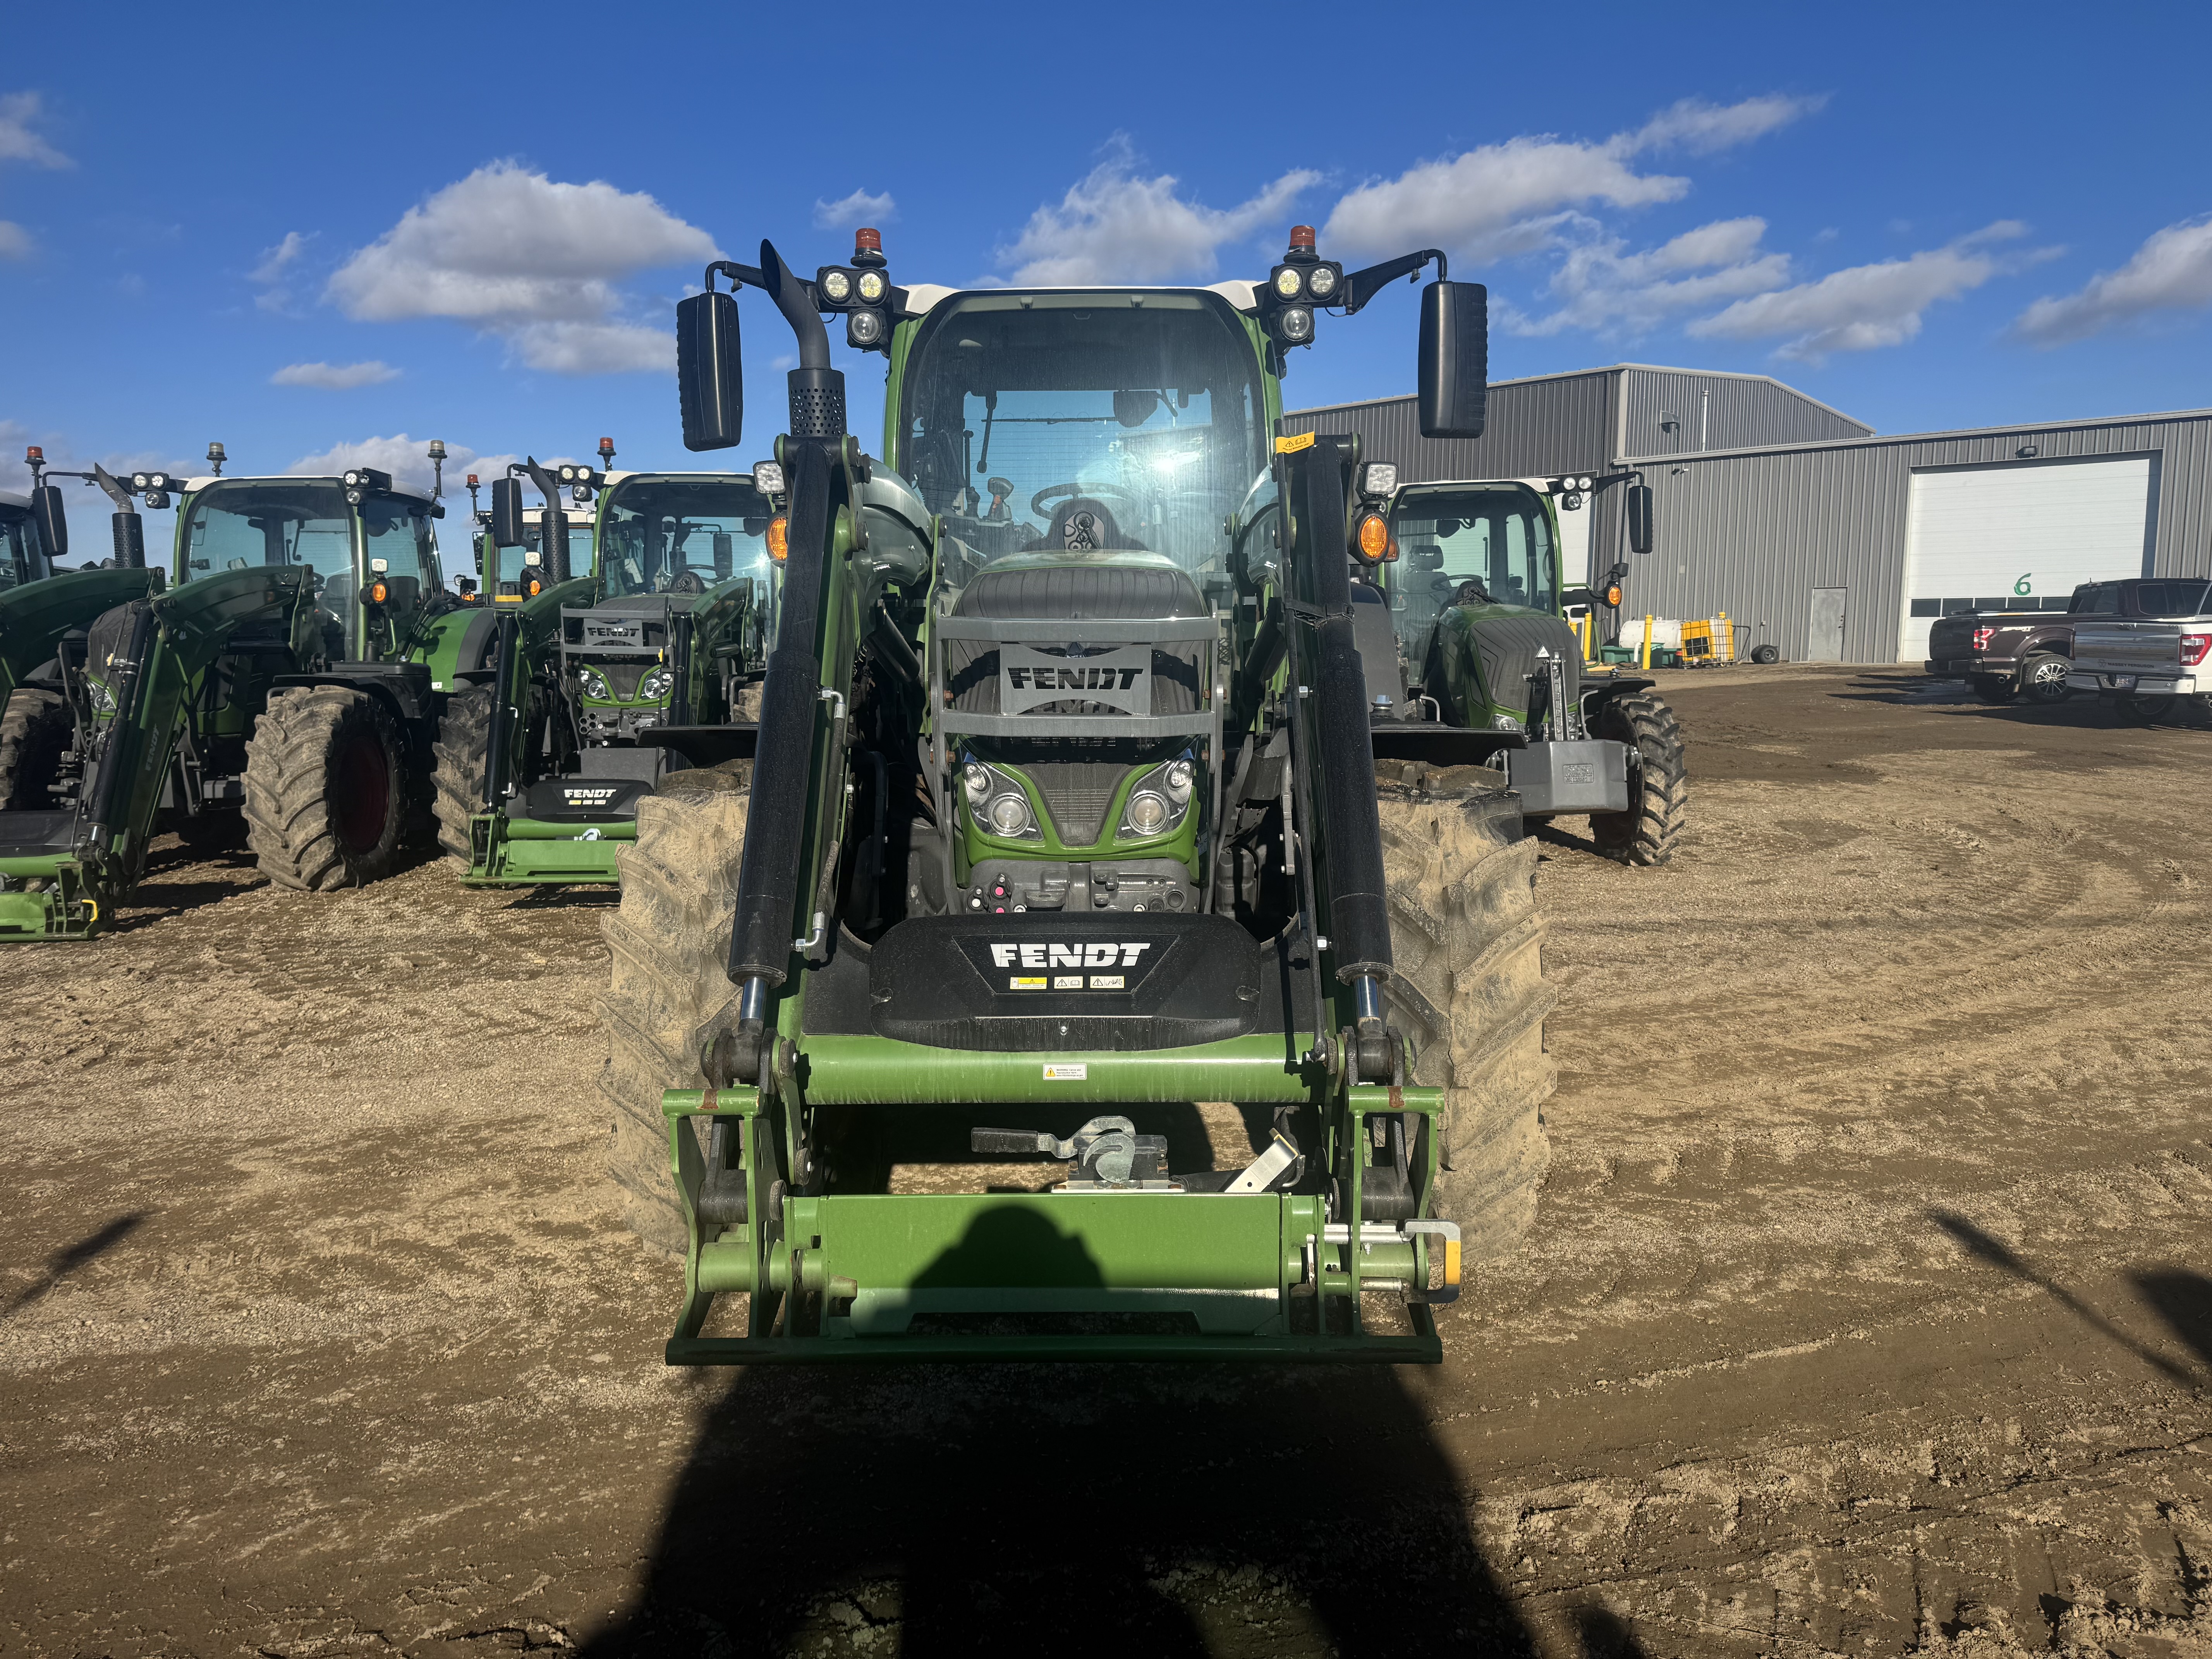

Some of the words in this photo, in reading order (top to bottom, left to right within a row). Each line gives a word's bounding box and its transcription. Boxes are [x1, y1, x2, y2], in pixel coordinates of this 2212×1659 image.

[2014, 573, 2031, 595] 6
[587, 627, 640, 637] FENDT
[1008, 668, 1144, 690] FENDT
[564, 789, 617, 798] FENDT
[990, 943, 1151, 967] FENDT
